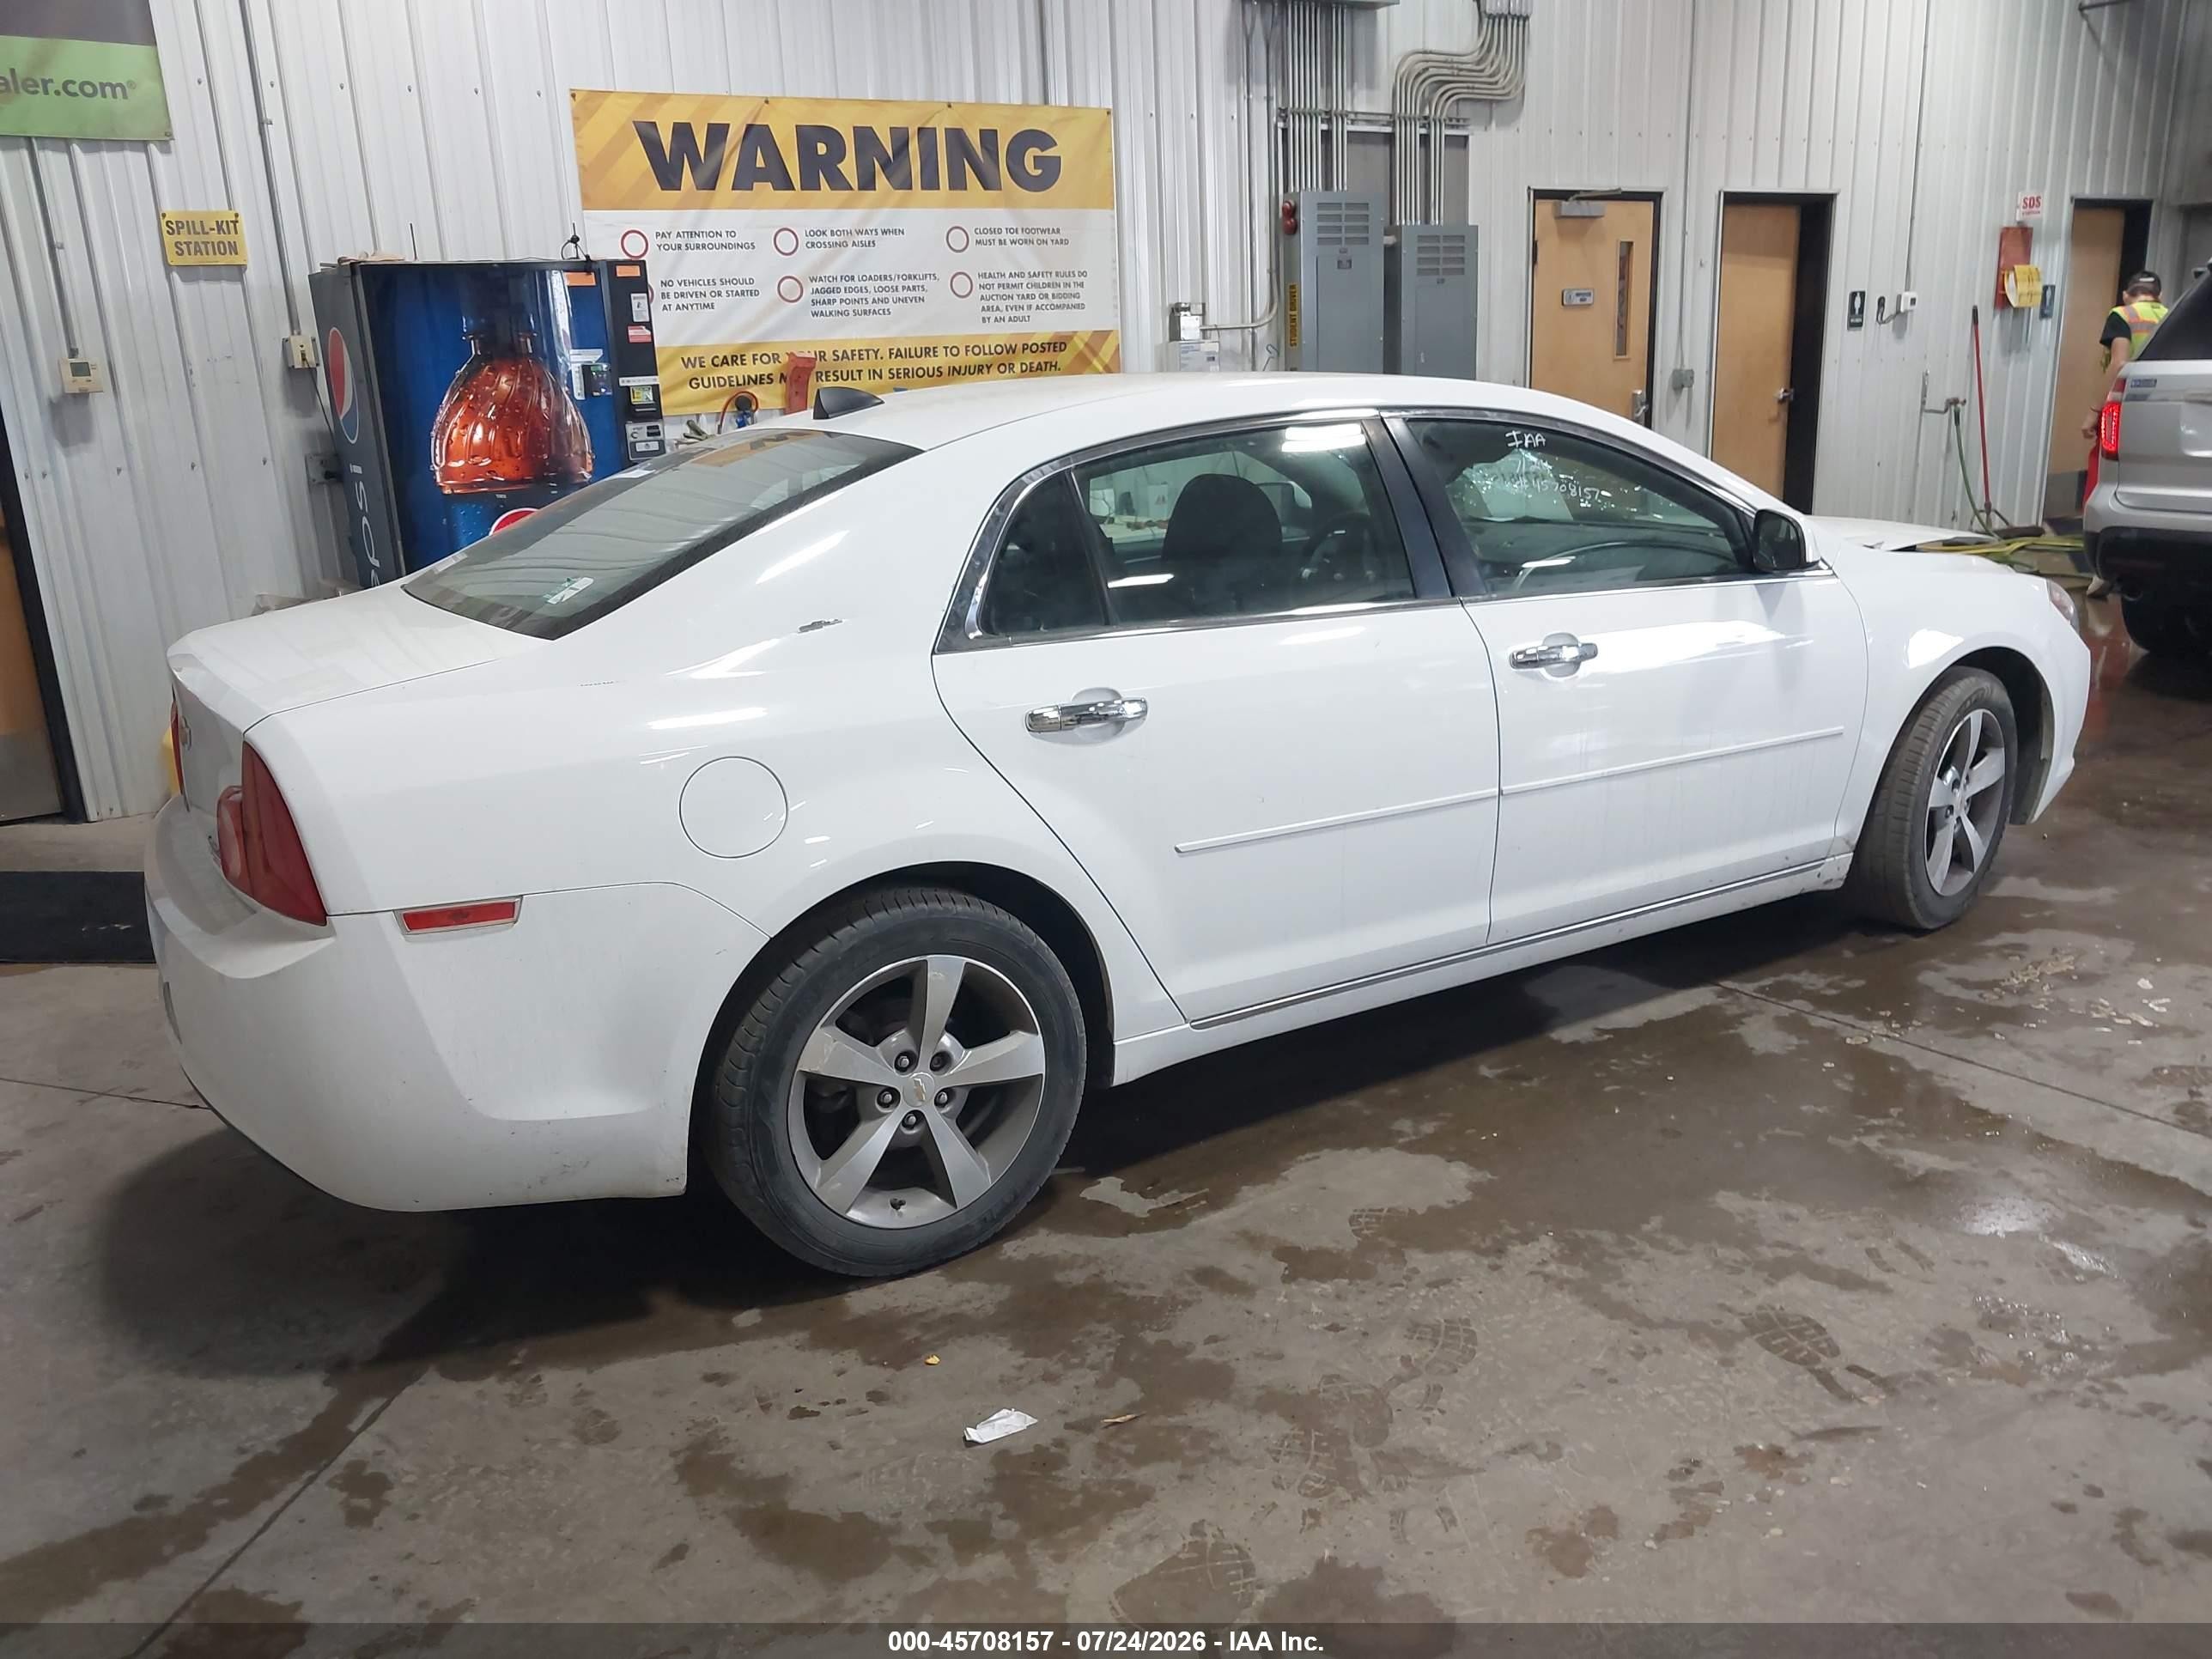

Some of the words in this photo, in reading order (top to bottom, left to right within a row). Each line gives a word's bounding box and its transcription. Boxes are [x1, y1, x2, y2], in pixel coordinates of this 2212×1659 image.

[632, 120, 1062, 193] WARNING
[2022, 196, 2041, 210] SDS
[165, 219, 240, 236] SPILL-KIT
[830, 228, 853, 237] BOTH
[854, 228, 878, 236] WAYS
[655, 230, 672, 240] PAY
[676, 230, 723, 240] ATTENTION
[725, 230, 737, 239] TO
[174, 240, 239, 256] STATION
[656, 242, 683, 252] YOUR
[684, 241, 756, 252] SURROUNDINGS
[805, 240, 849, 249] CROSSING
[851, 240, 876, 248] AISLES
[660, 279, 674, 288] NO
[676, 278, 717, 288] VEHICLES
[720, 276, 755, 286] SHOULD
[808, 275, 838, 283] WATCH
[857, 273, 939, 282] LOADERS/FORKLIFTS,
[660, 291, 671, 300] BE
[673, 290, 708, 300] DRIVEN
[709, 289, 723, 299] OR
[726, 289, 760, 298] STARTED
[843, 286, 872, 295] EDGES,
[675, 301, 715, 311] ANYTIME
[811, 298, 837, 307] SHARP
[839, 297, 869, 306] POINTS
[811, 309, 850, 318] WALKING
[852, 308, 891, 317] SURFACES
[1005, 304, 1024, 313] EVEN
[681, 356, 706, 369] WE
[711, 354, 747, 368] CARE
[752, 352, 781, 365] FOR
[832, 349, 884, 362] SAFETY.
[888, 345, 939, 360] FAILURE
[943, 345, 960, 358] TO
[965, 343, 1018, 357] FOLLOW
[1022, 342, 1066, 355] POSTED
[689, 373, 774, 389] GUIDELINES
[816, 369, 863, 382] RESULT
[867, 368, 883, 380] IN
[888, 366, 943, 380] SERIOUS
[947, 363, 993, 378] INJURY
[997, 362, 1015, 374] OR
[1020, 361, 1060, 374] DEATH.
[1505, 430, 1546, 447] IAA
